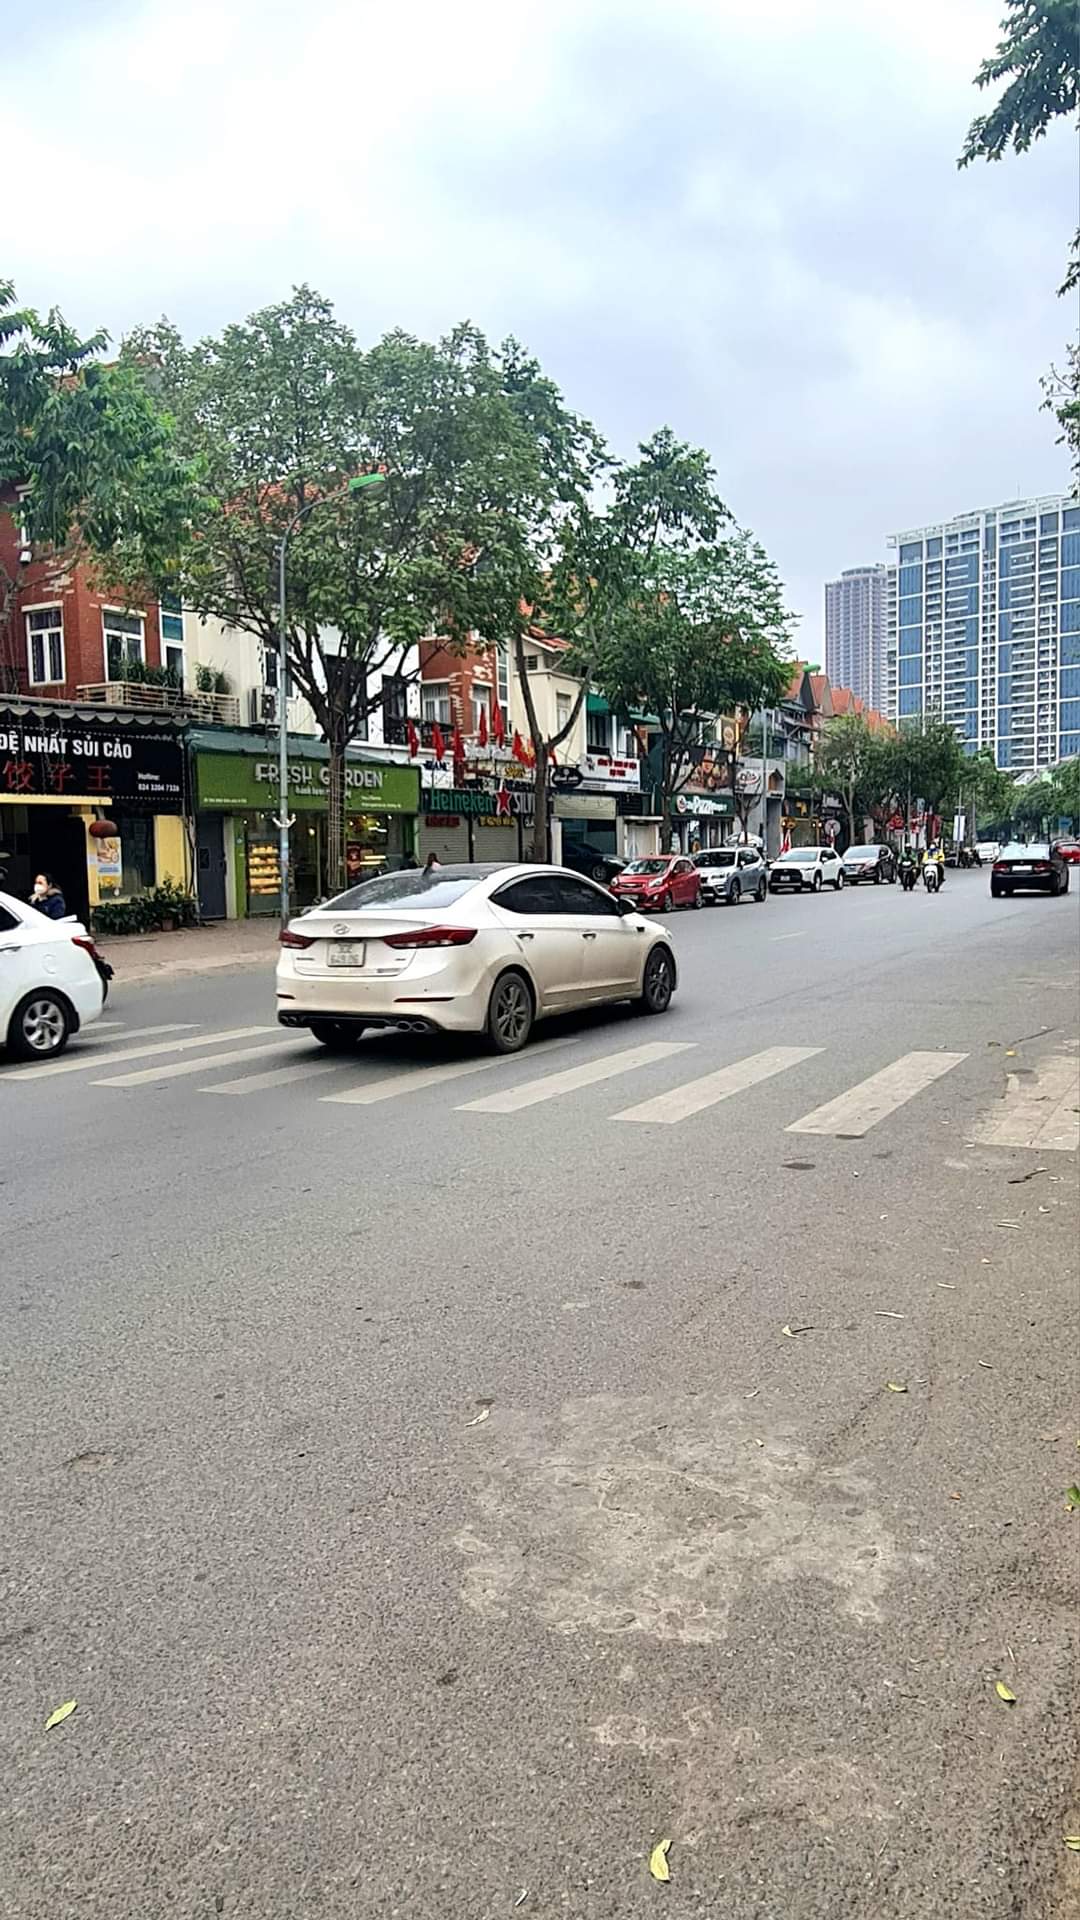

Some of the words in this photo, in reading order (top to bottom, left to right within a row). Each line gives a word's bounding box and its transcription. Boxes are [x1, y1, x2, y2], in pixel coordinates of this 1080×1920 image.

[24, 731, 68, 754] NHẤT
[72, 734, 99, 757] SỦI
[103, 737, 132, 759] CẢO
[320, 766, 383, 788] GRDEN
[431, 790, 494, 813] Heineken
